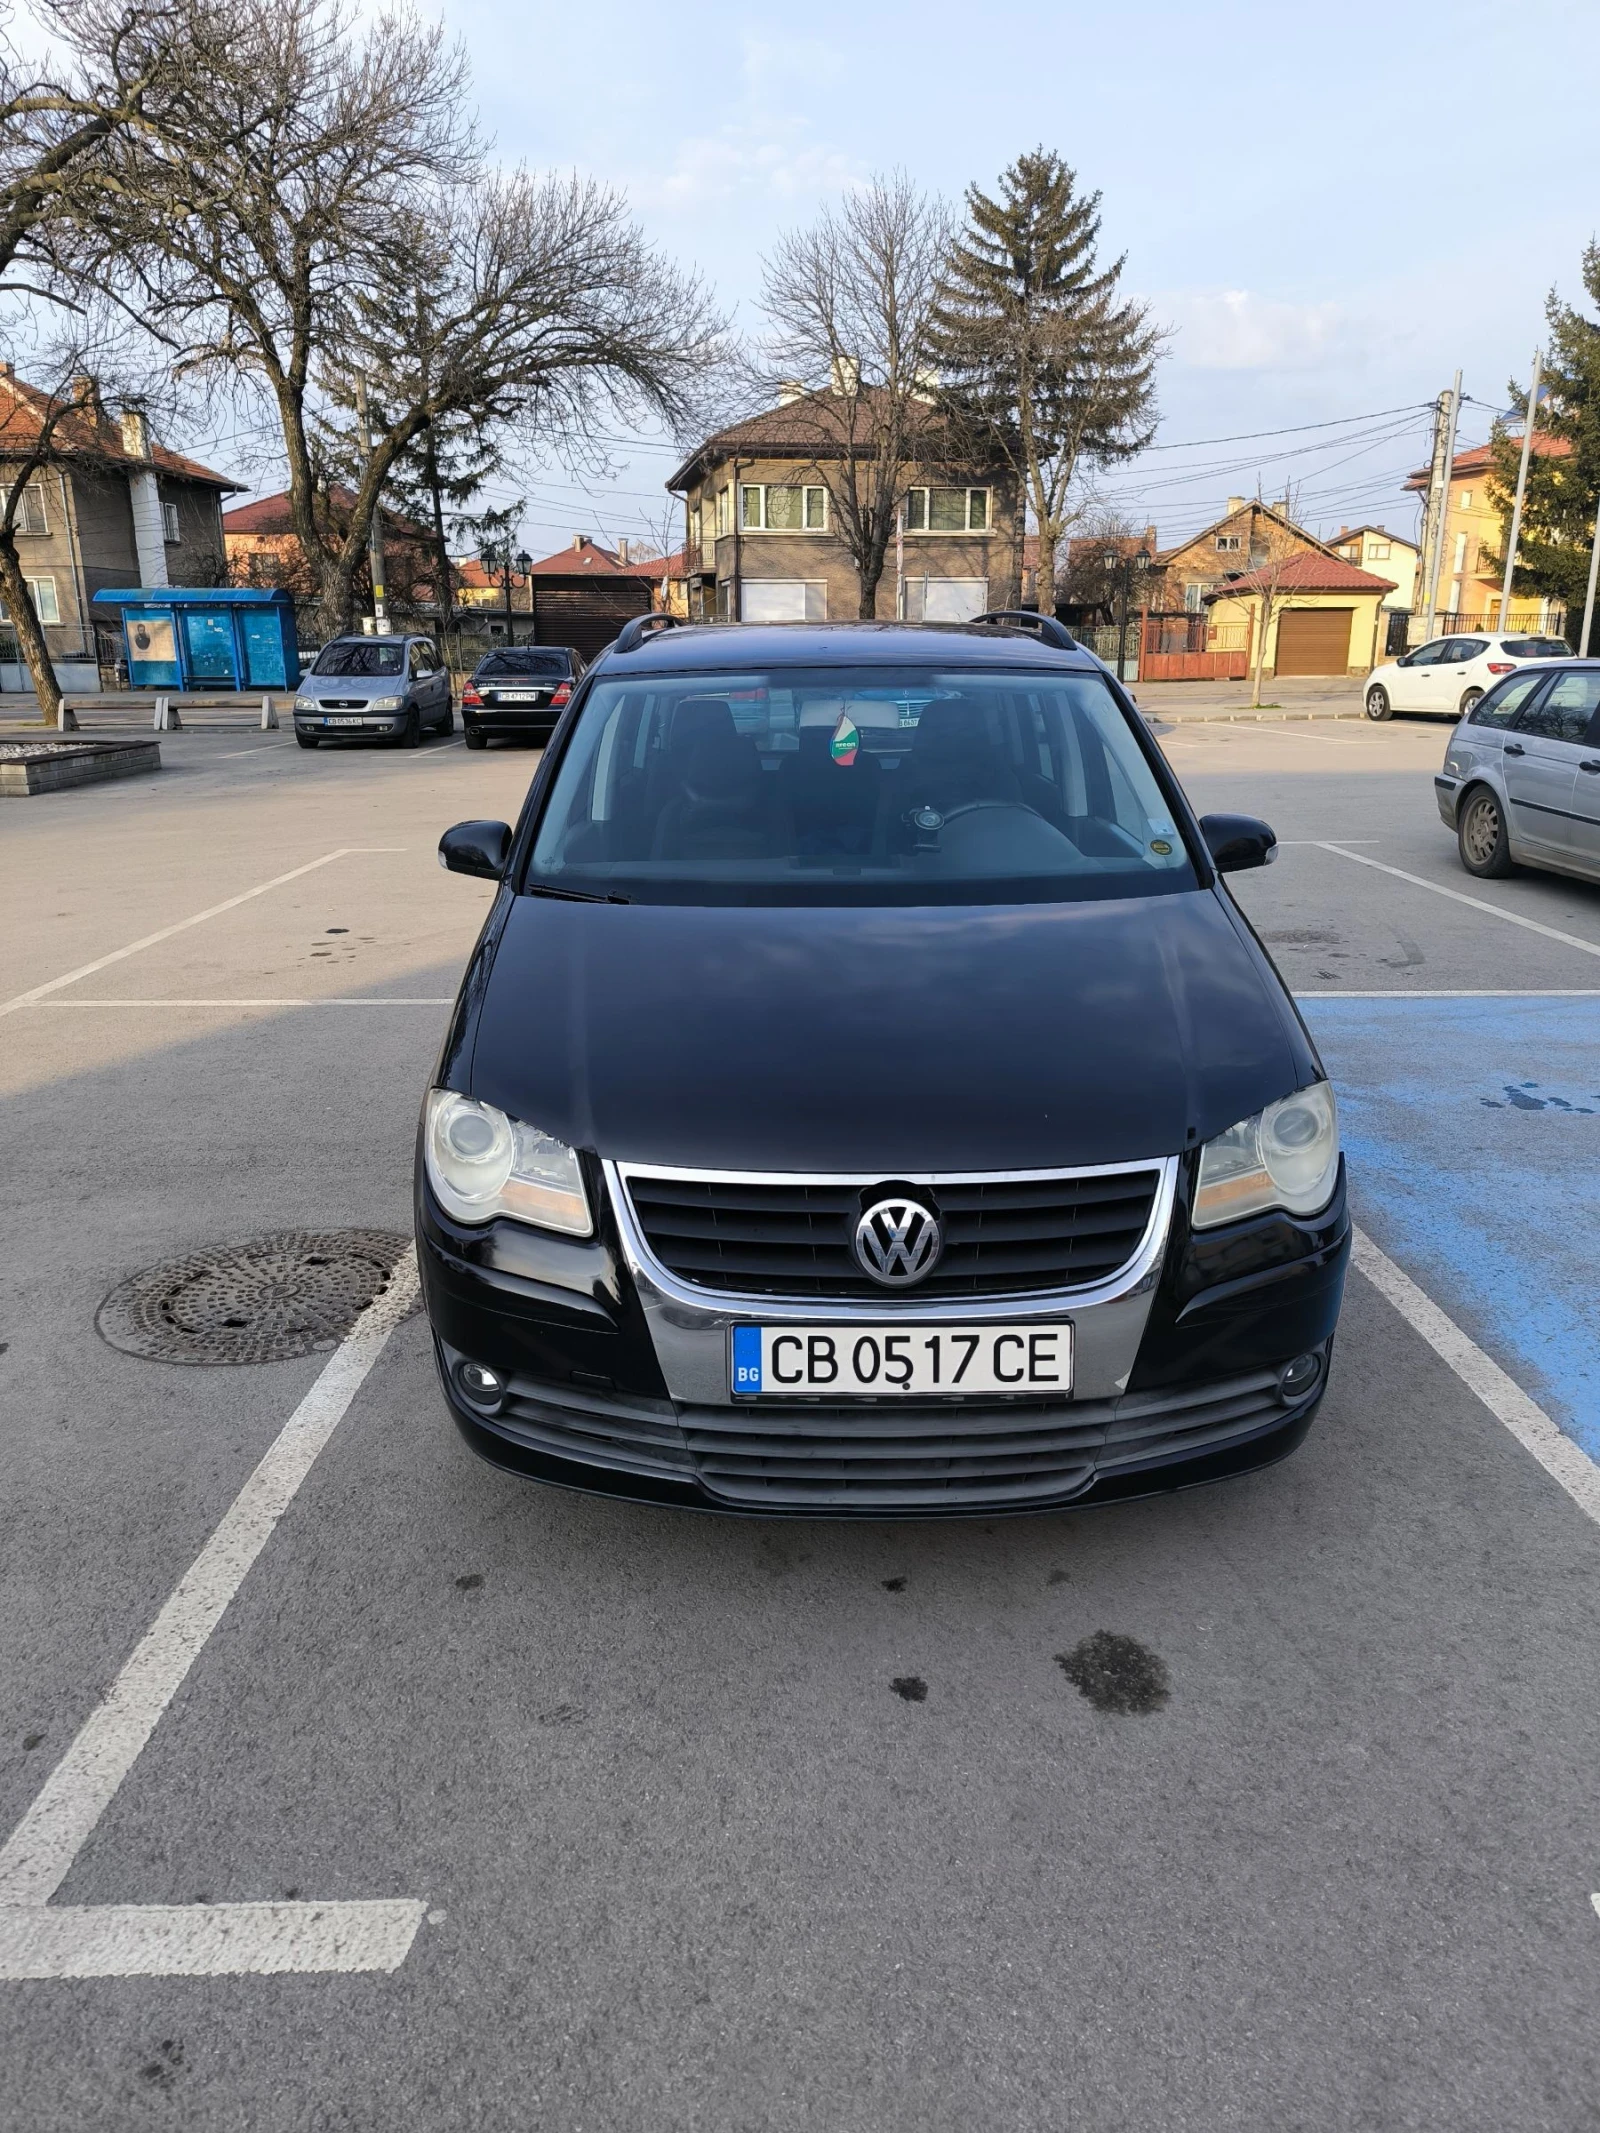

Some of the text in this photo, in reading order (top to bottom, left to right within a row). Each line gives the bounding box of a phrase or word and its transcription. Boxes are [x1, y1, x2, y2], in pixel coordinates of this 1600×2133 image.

[738, 1333, 1060, 1384] BG CB 0517 CE
